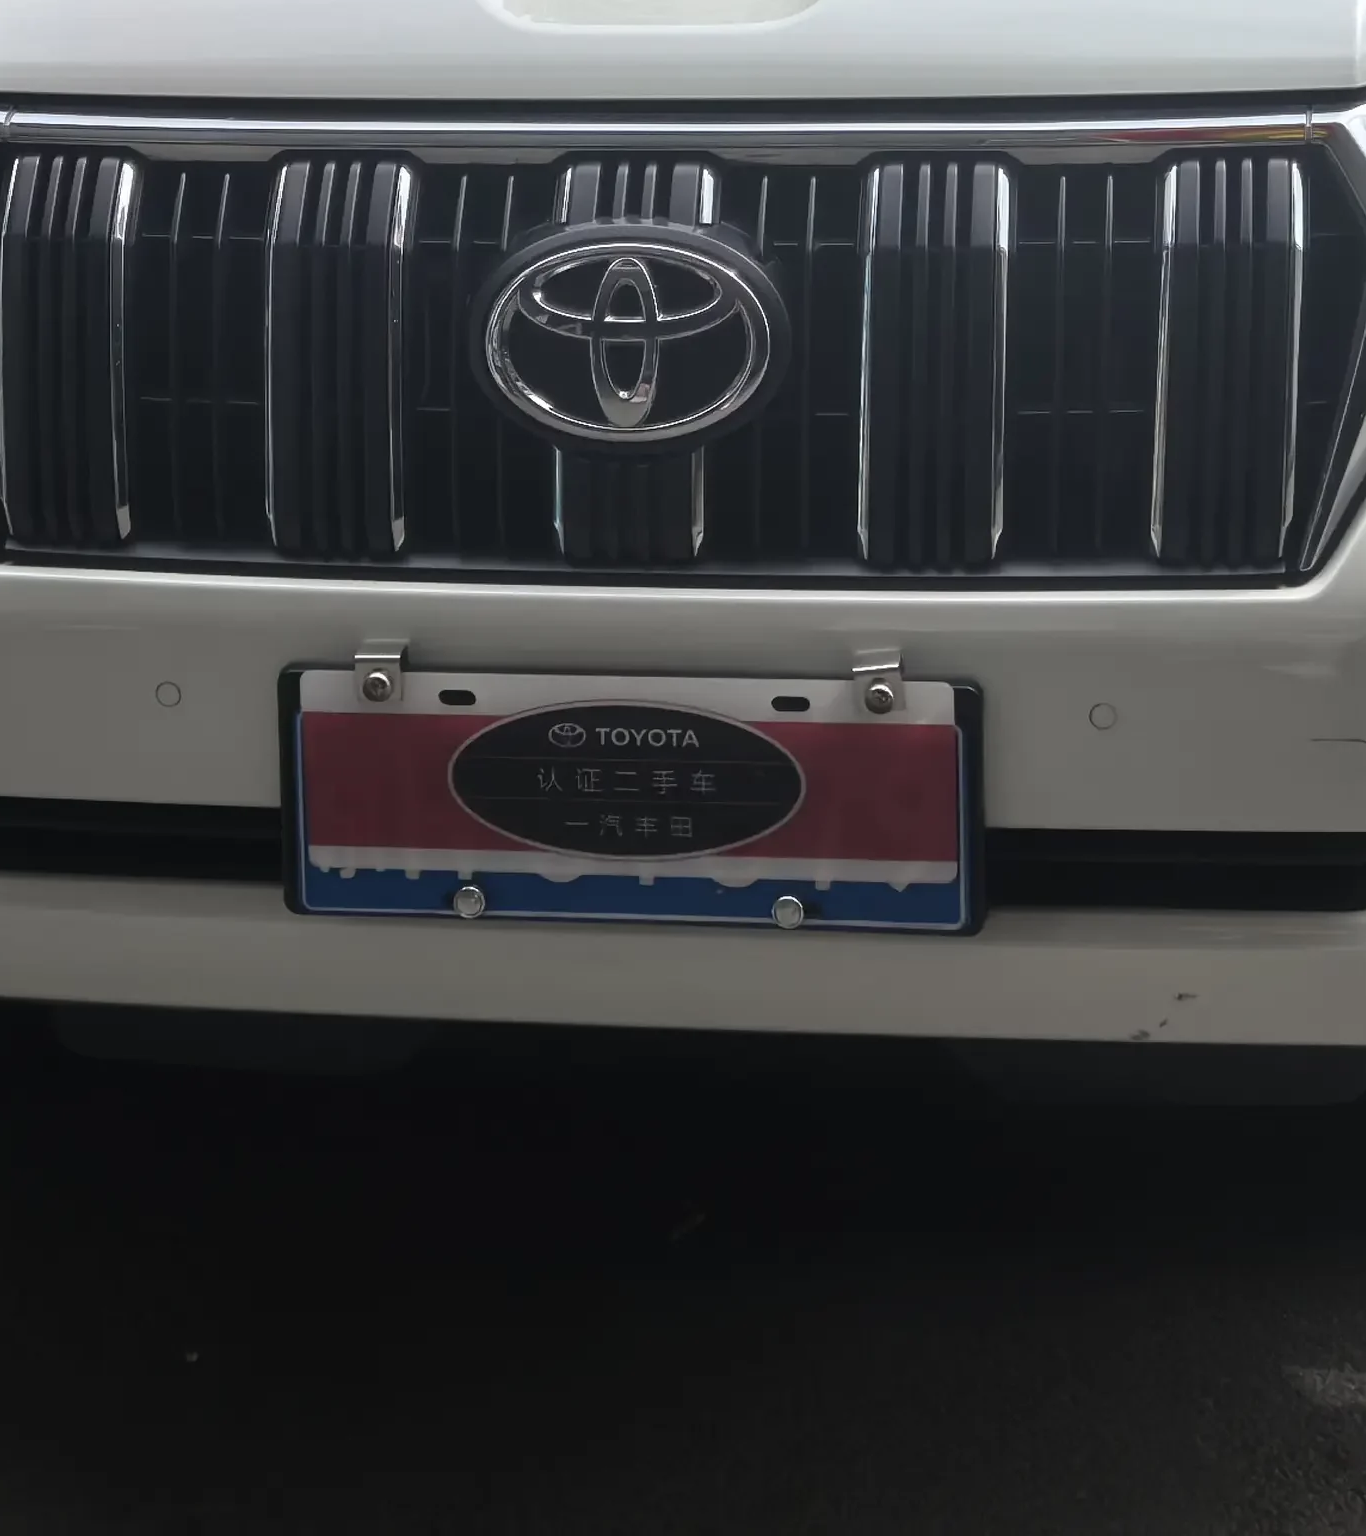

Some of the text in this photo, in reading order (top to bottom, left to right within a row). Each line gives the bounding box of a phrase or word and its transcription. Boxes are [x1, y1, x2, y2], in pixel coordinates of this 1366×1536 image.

[595, 727, 700, 748] TOYOTA
[536, 766, 717, 795] 认证二手车
[563, 814, 693, 839] 一汽丰田
